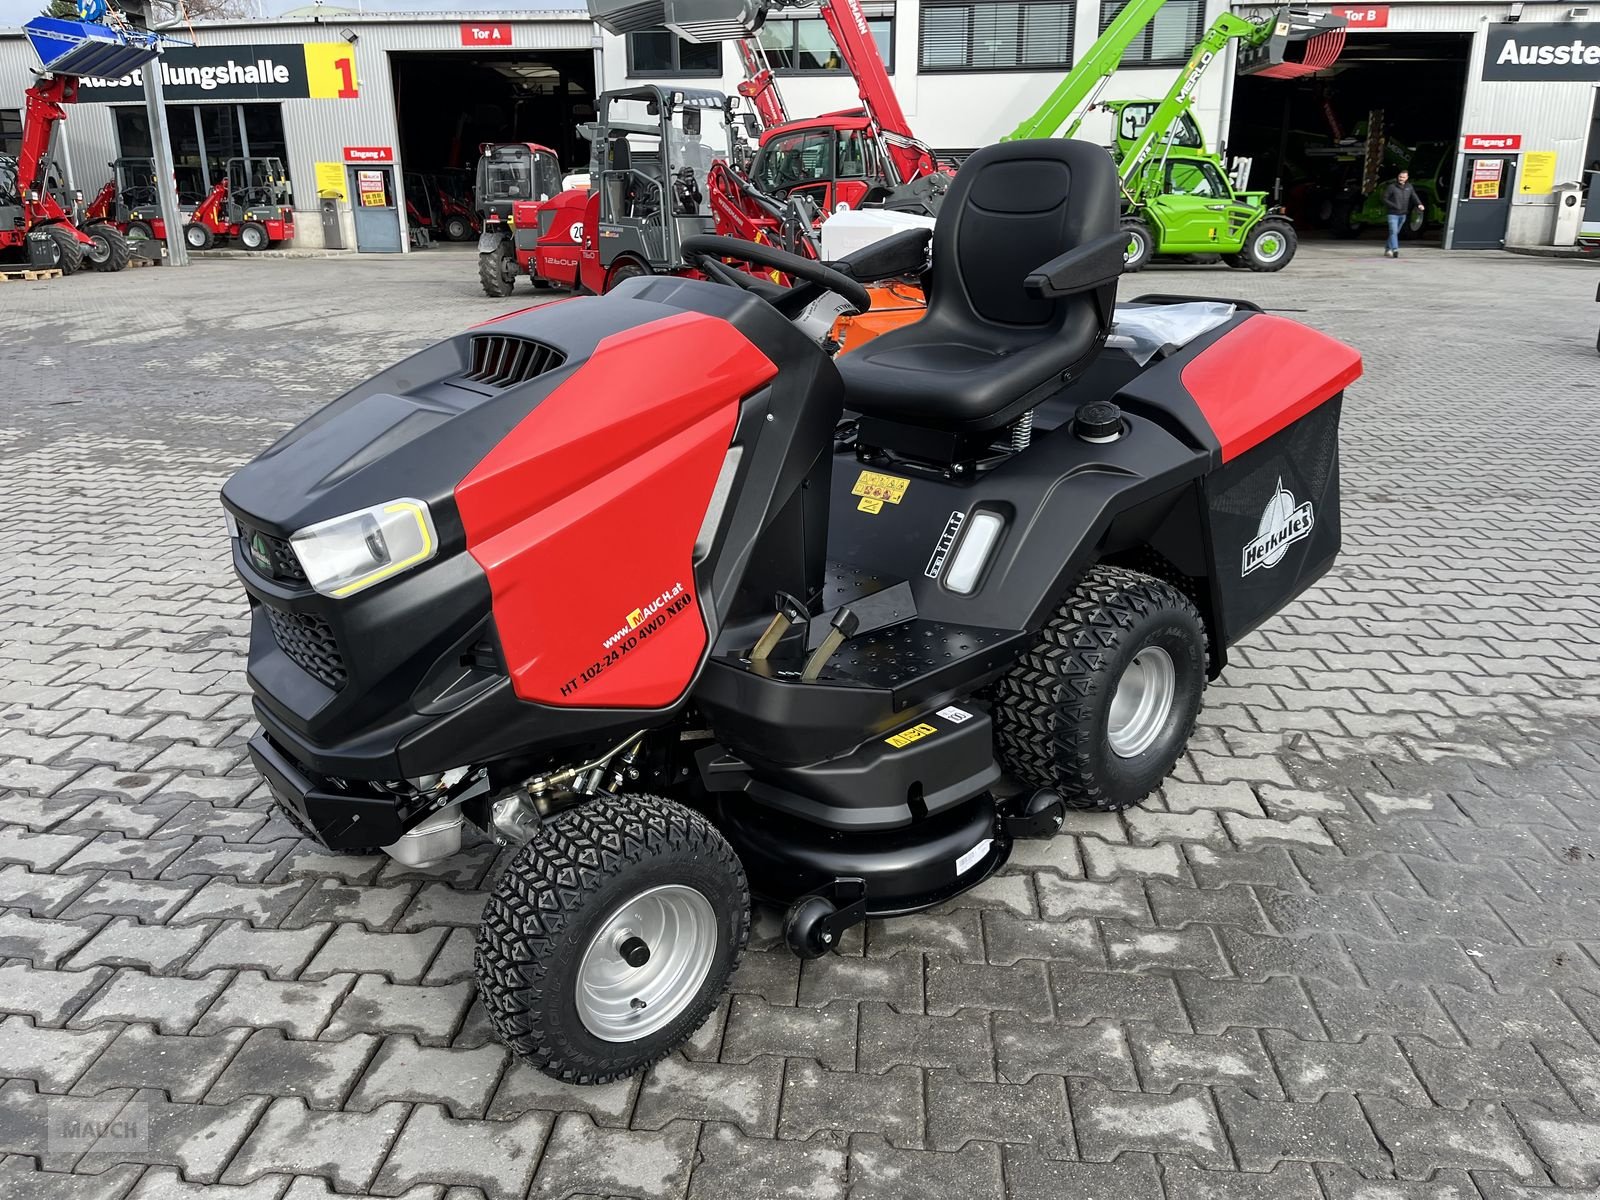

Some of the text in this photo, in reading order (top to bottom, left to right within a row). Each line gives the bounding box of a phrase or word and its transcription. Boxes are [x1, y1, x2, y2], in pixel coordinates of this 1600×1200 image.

[1344, 9, 1377, 21] Tor B
[471, 27, 501, 40] Tor A
[1496, 39, 1600, 65] Ausste
[334, 57, 359, 98] 1
[1175, 51, 1213, 104] MERLO
[350, 150, 378, 159] Eingang
[1472, 138, 1513, 147] Eingang B
[1246, 514, 1310, 568] Herkules
[602, 582, 684, 649] www.MAUCH.at
[560, 593, 692, 697] HT 102-24 XD 4WD NEO
